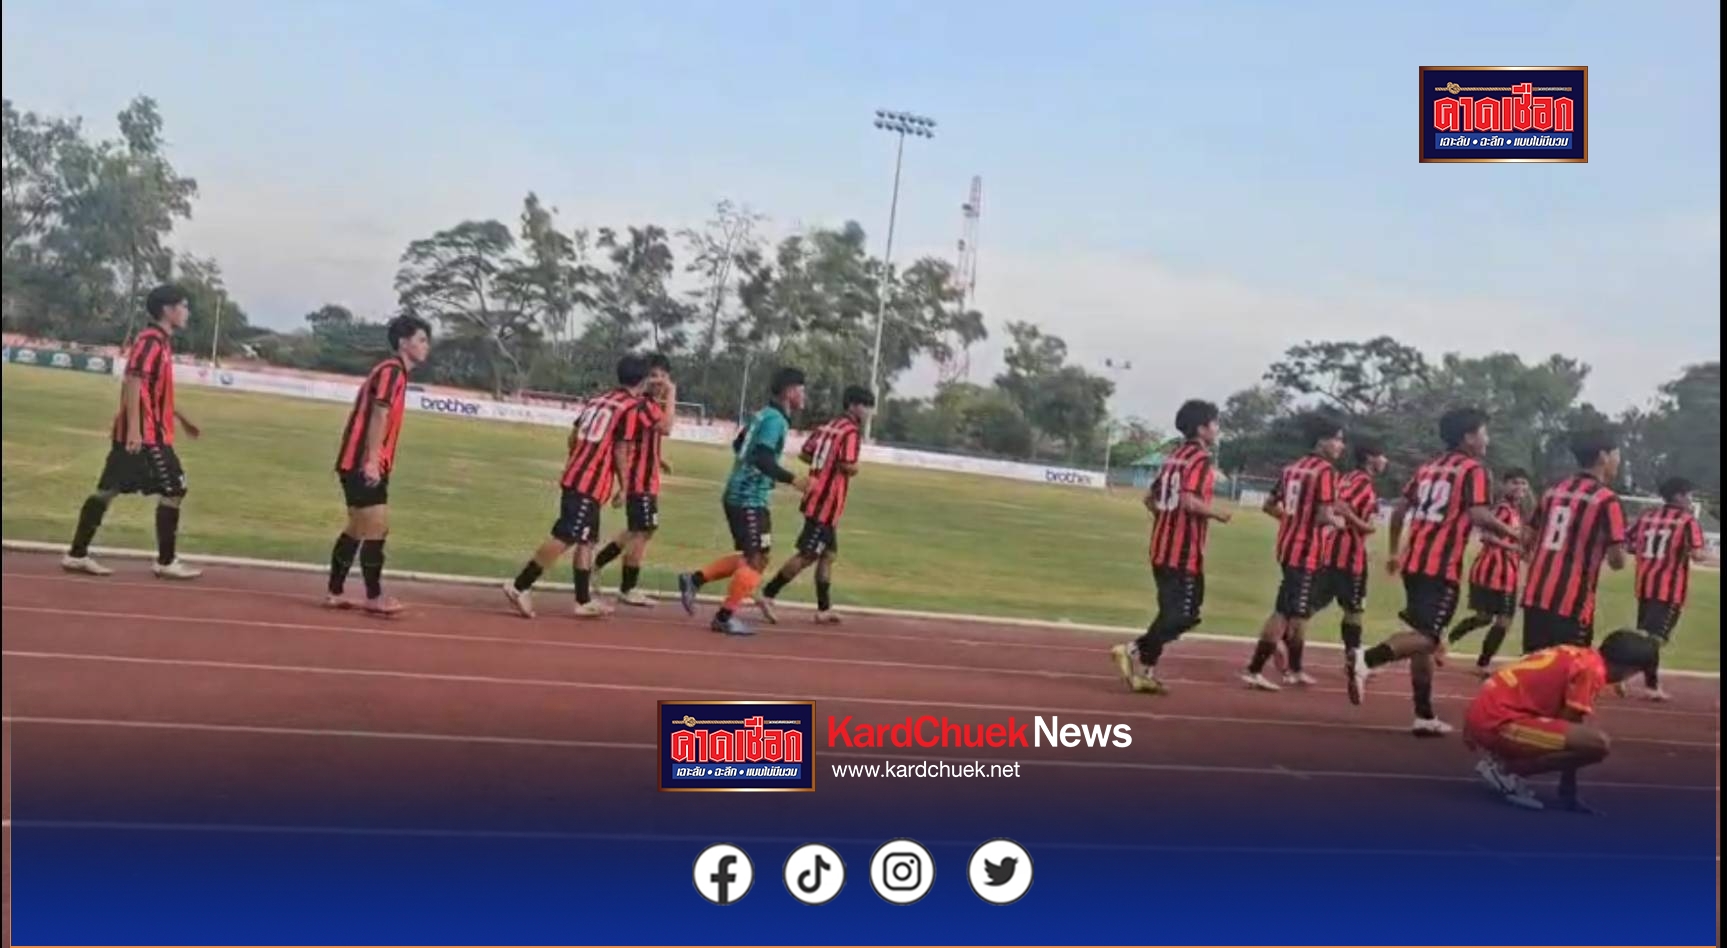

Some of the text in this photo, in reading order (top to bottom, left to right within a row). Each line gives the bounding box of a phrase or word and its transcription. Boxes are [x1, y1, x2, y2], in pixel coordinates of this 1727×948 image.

[420, 396, 480, 415] brother
[1544, 506, 1571, 551] 8
[1642, 528, 1672, 559] 17
